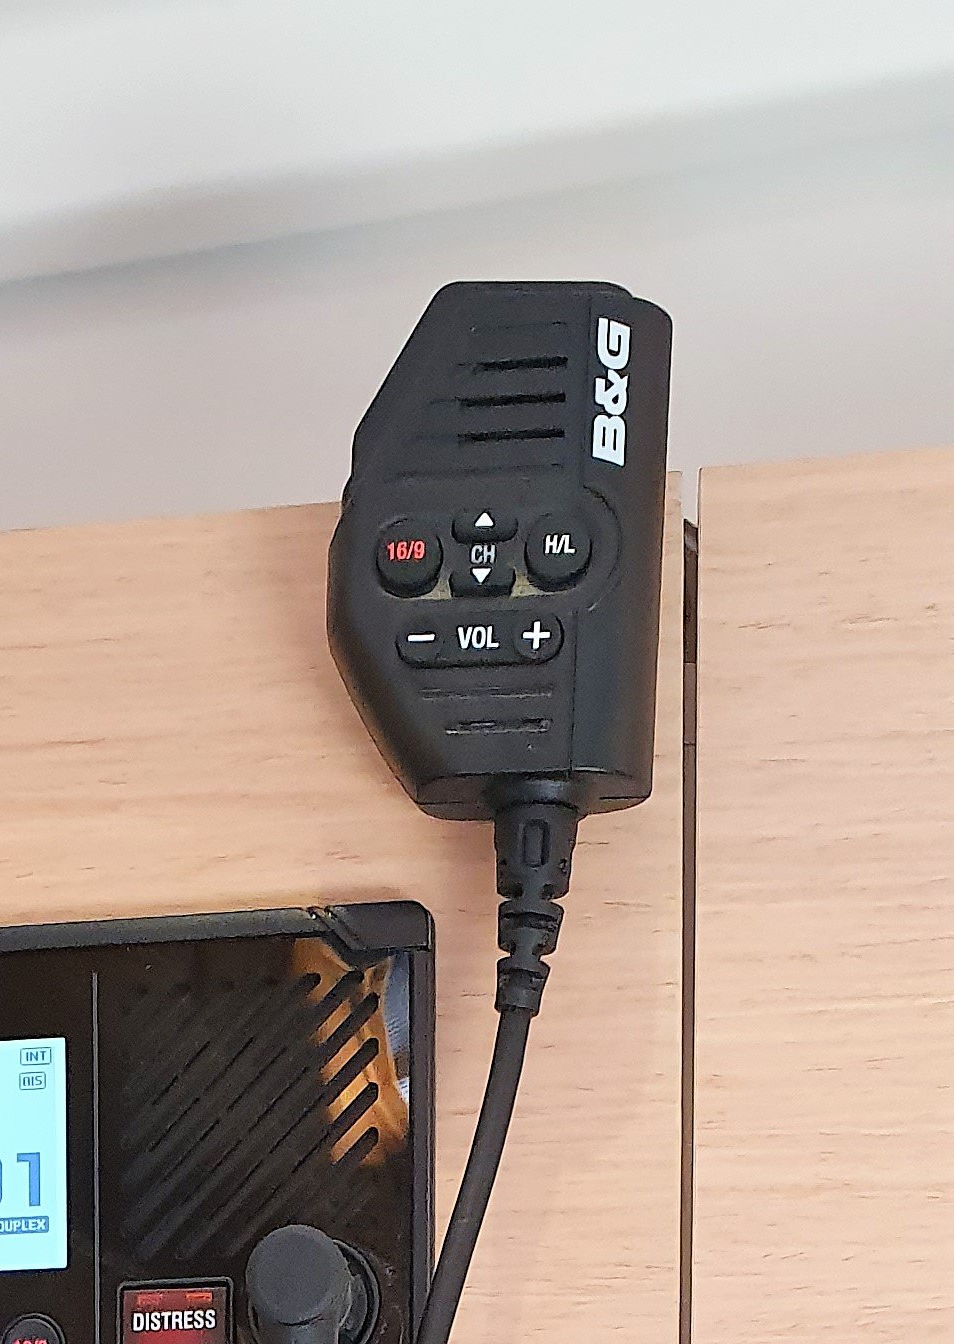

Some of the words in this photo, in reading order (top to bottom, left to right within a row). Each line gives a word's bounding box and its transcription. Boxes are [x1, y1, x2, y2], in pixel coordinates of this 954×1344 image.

[592, 317, 632, 467] B&G
[386, 541, 425, 561] 16/9
[544, 534, 576, 554] H/L
[471, 545, 496, 564] CH
[457, 626, 499, 650] VOL
[25, 1050, 47, 1062] INT
[132, 1309, 216, 1332] DISTRESS
